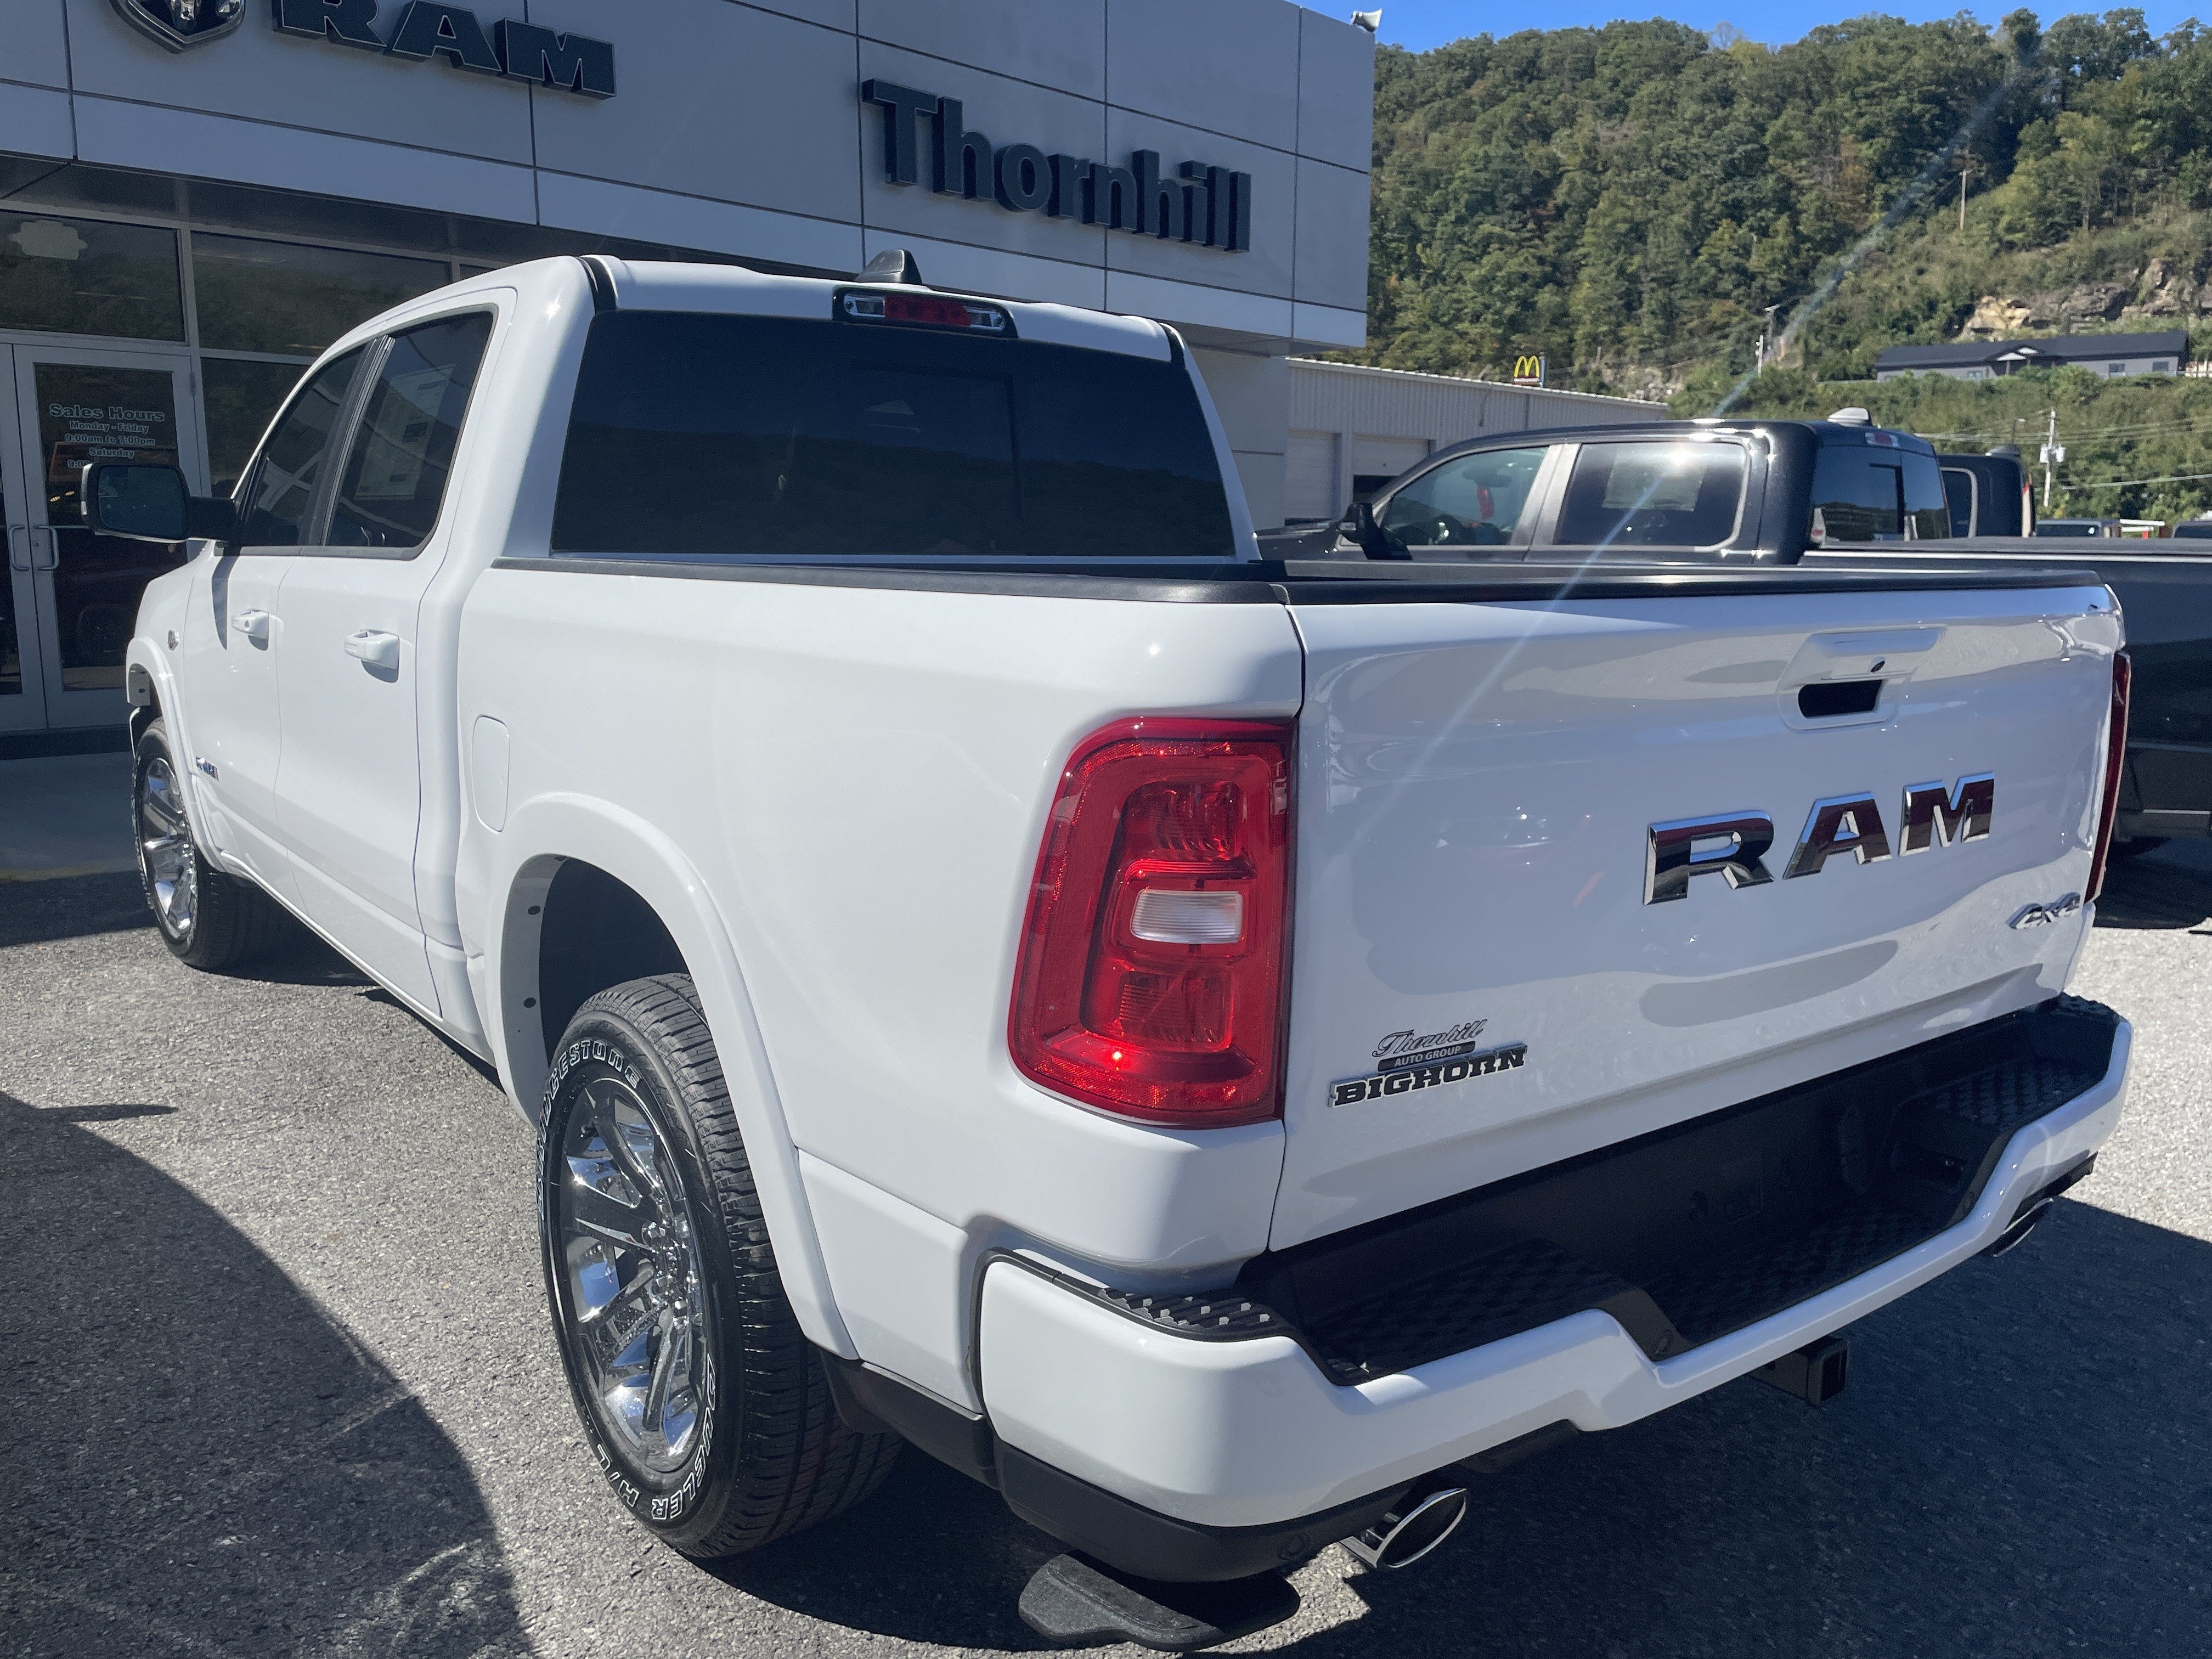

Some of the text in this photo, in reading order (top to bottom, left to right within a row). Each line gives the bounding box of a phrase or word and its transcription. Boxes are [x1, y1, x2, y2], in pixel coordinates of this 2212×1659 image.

[273, 0, 616, 100] RAM
[862, 78, 1251, 252] Thornhill
[49, 403, 165, 421] Sales Hours
[70, 420, 110, 432] Monday
[117, 423, 149, 435] Friday
[65, 433, 104, 443] 9:00am
[118, 436, 155, 447] 7:00pm
[89, 447, 135, 459] Saturday
[1644, 771, 1994, 905] RAM
[1372, 1019, 1488, 1057] Thornhill
[1394, 1045, 1462, 1067] AUTO GROUP
[1328, 1043, 1527, 1108] BIGHORN
[651, 1353, 716, 1520] DUELER
